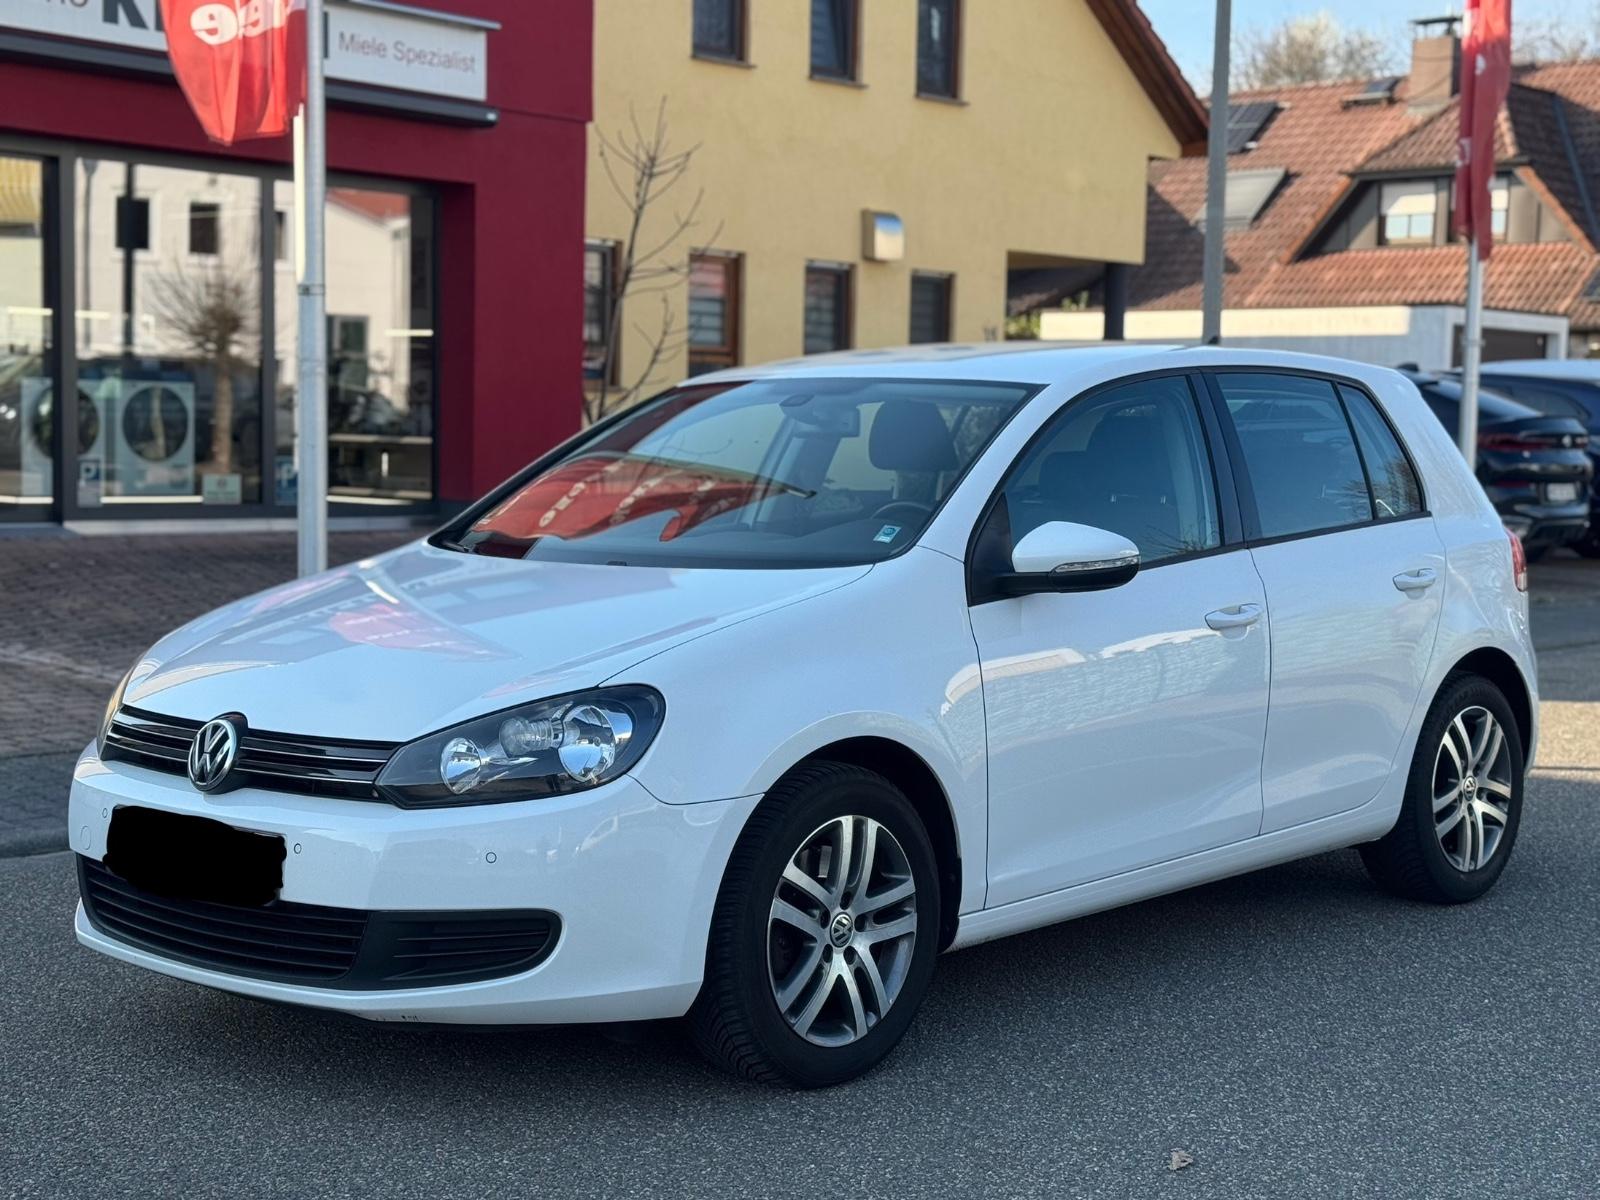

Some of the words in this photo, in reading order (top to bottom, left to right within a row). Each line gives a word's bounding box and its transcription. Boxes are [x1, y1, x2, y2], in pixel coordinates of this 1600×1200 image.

[338, 31, 388, 59] Miele
[393, 39, 476, 74] Spezialist
[190, 721, 233, 786] VW
